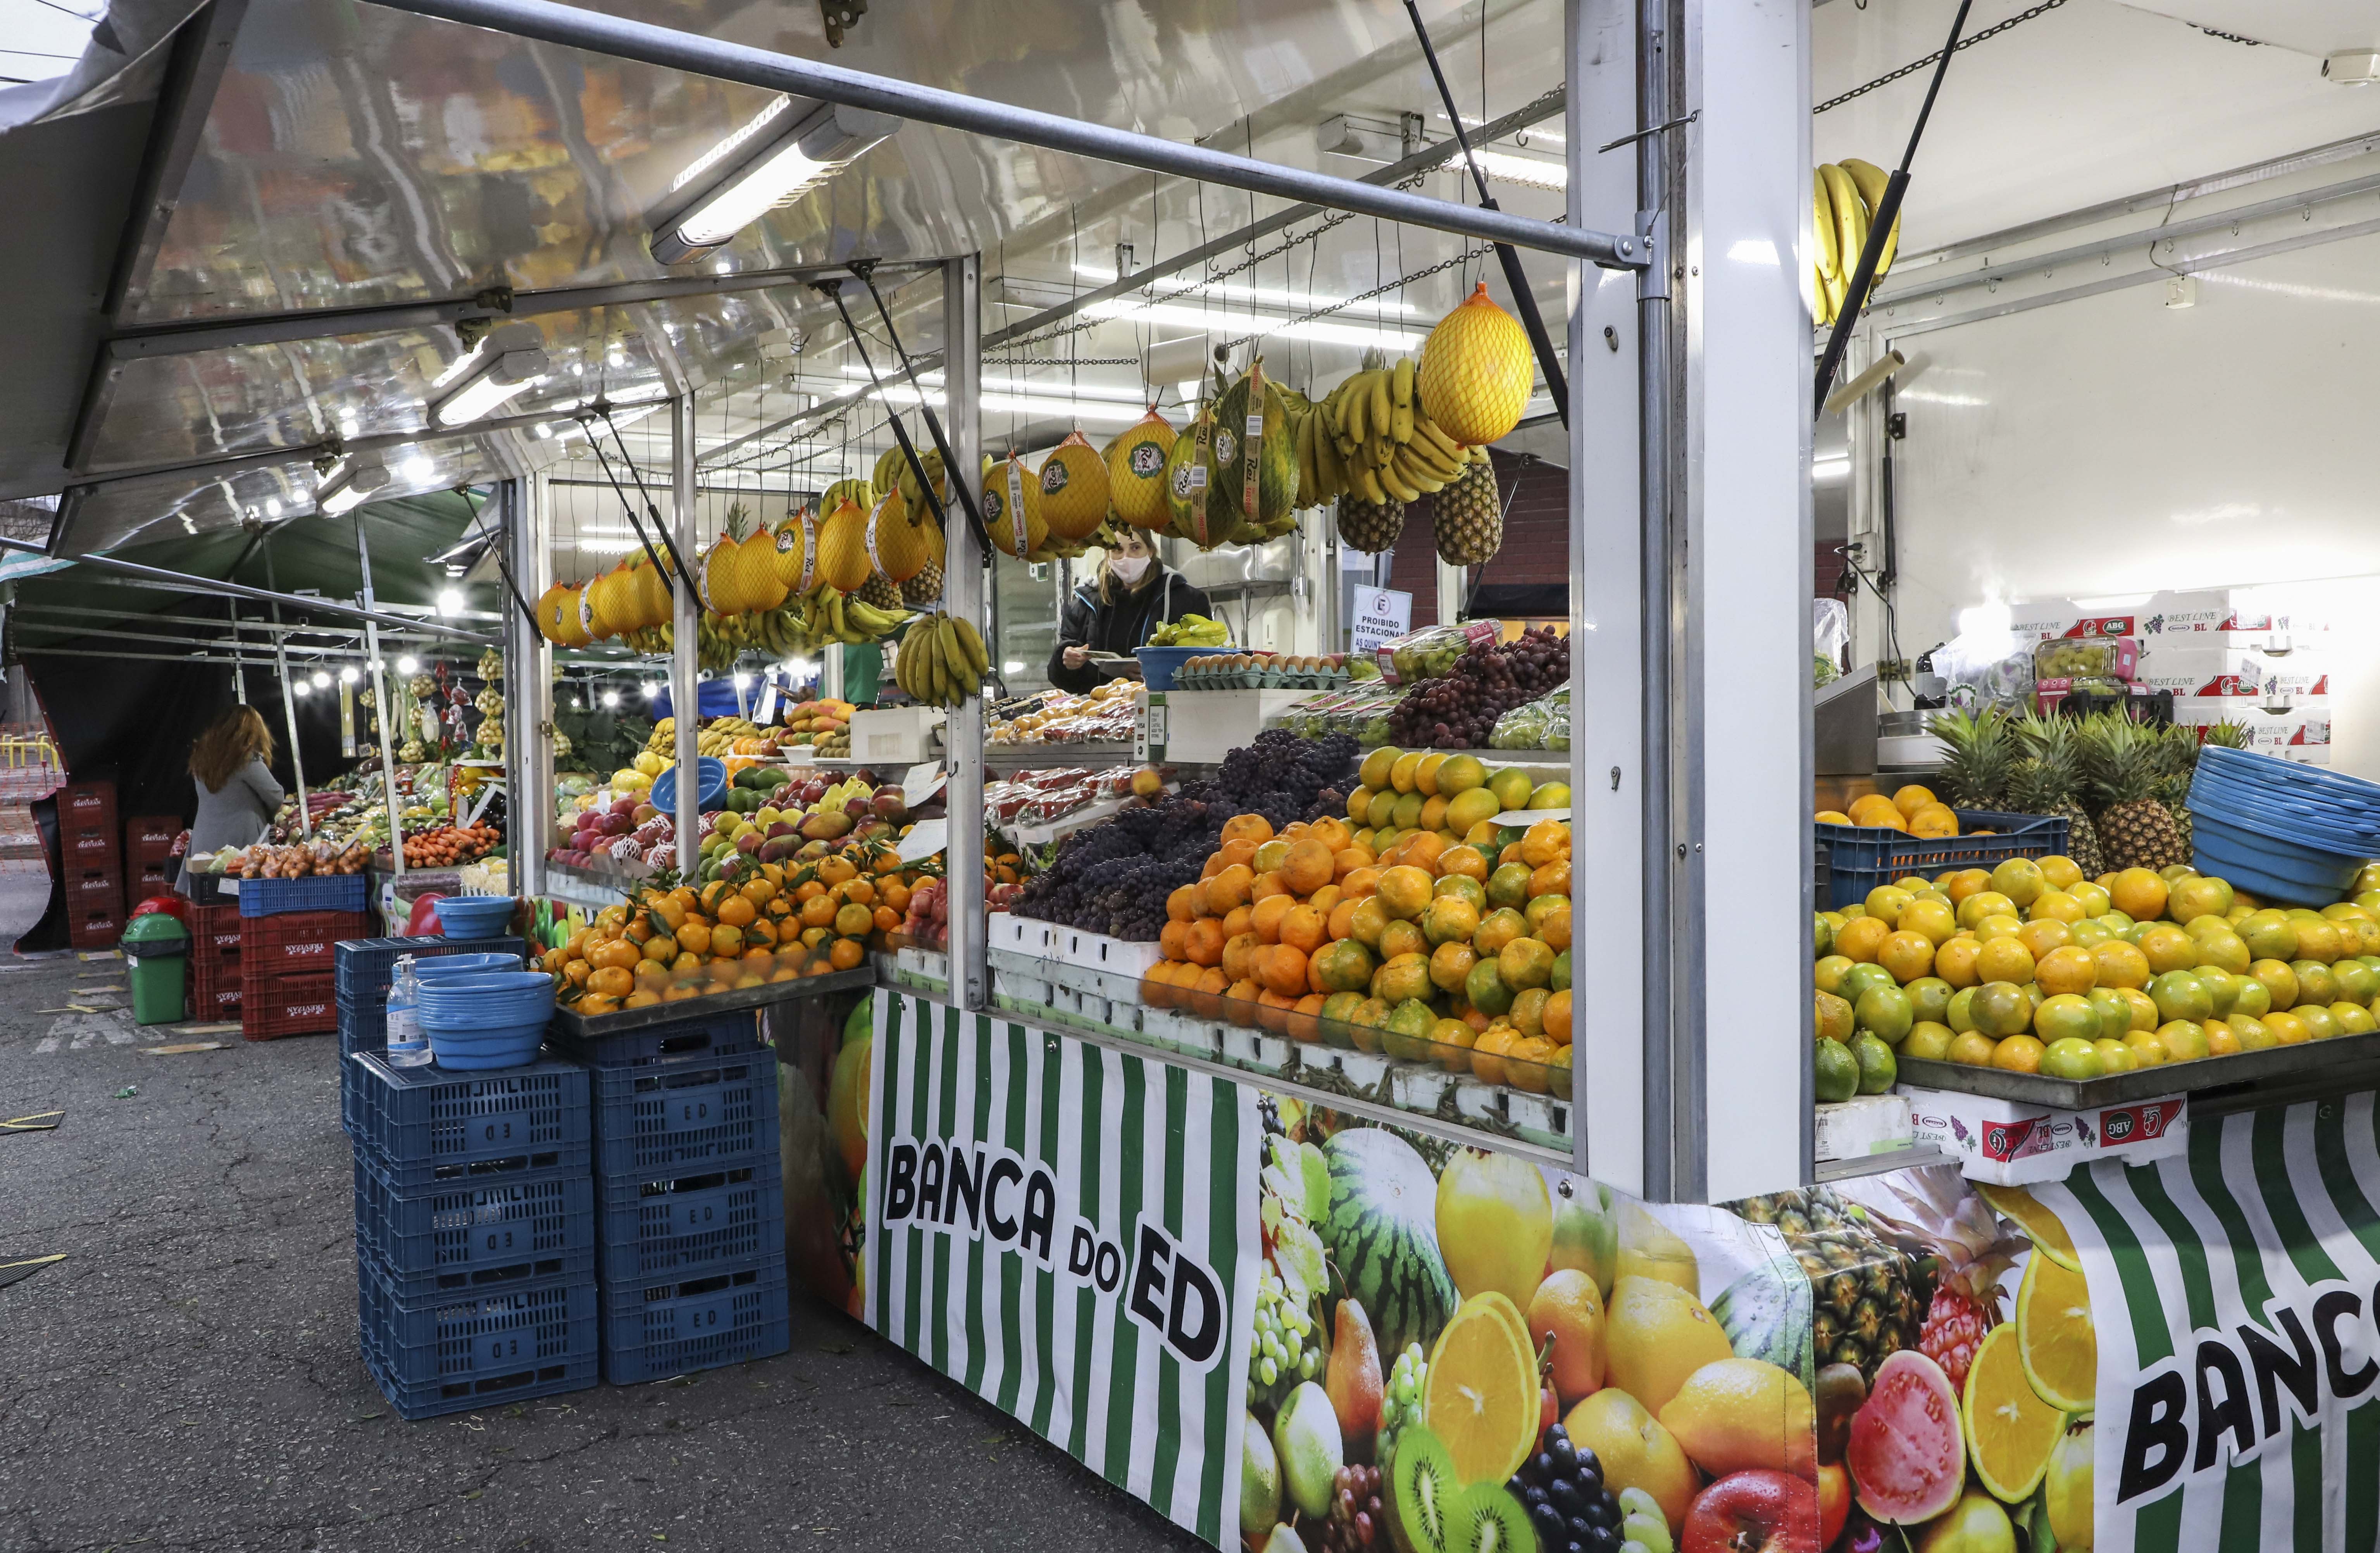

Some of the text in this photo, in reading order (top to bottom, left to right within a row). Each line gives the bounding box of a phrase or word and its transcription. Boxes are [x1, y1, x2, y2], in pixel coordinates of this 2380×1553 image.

[1140, 447, 1152, 469] Rei
[1017, 540, 1026, 555] Rei
[805, 557, 813, 573] Rei
[1362, 616, 1399, 628] PROIBIDO
[2168, 612, 2217, 622] BEST LINE
[2040, 622, 2061, 630] LINE
[2194, 623, 2207, 631] BL
[1356, 638, 1384, 649] AS QUINT
[2171, 677, 2195, 686] LINE
[2173, 688, 2186, 696] BL
[2273, 726, 2289, 734] LINE
[2274, 737, 2283, 745] BL
[214, 934, 241, 943] EVIZAN
[286, 943, 324, 954] TREVIZAN
[216, 991, 242, 1001] EVIZAN
[287, 1005, 326, 1016] TREVIZAN
[1912, 1113, 1920, 1126] B
[2037, 1125, 2050, 1138] BL
[2108, 1120, 2131, 1134] ABG
[1920, 1132, 1946, 1141] BEST
[2050, 1140, 2072, 1151] BEST
[886, 1143, 1221, 1362] BANCA DO ED
[2117, 1281, 2380, 1506] BANC
